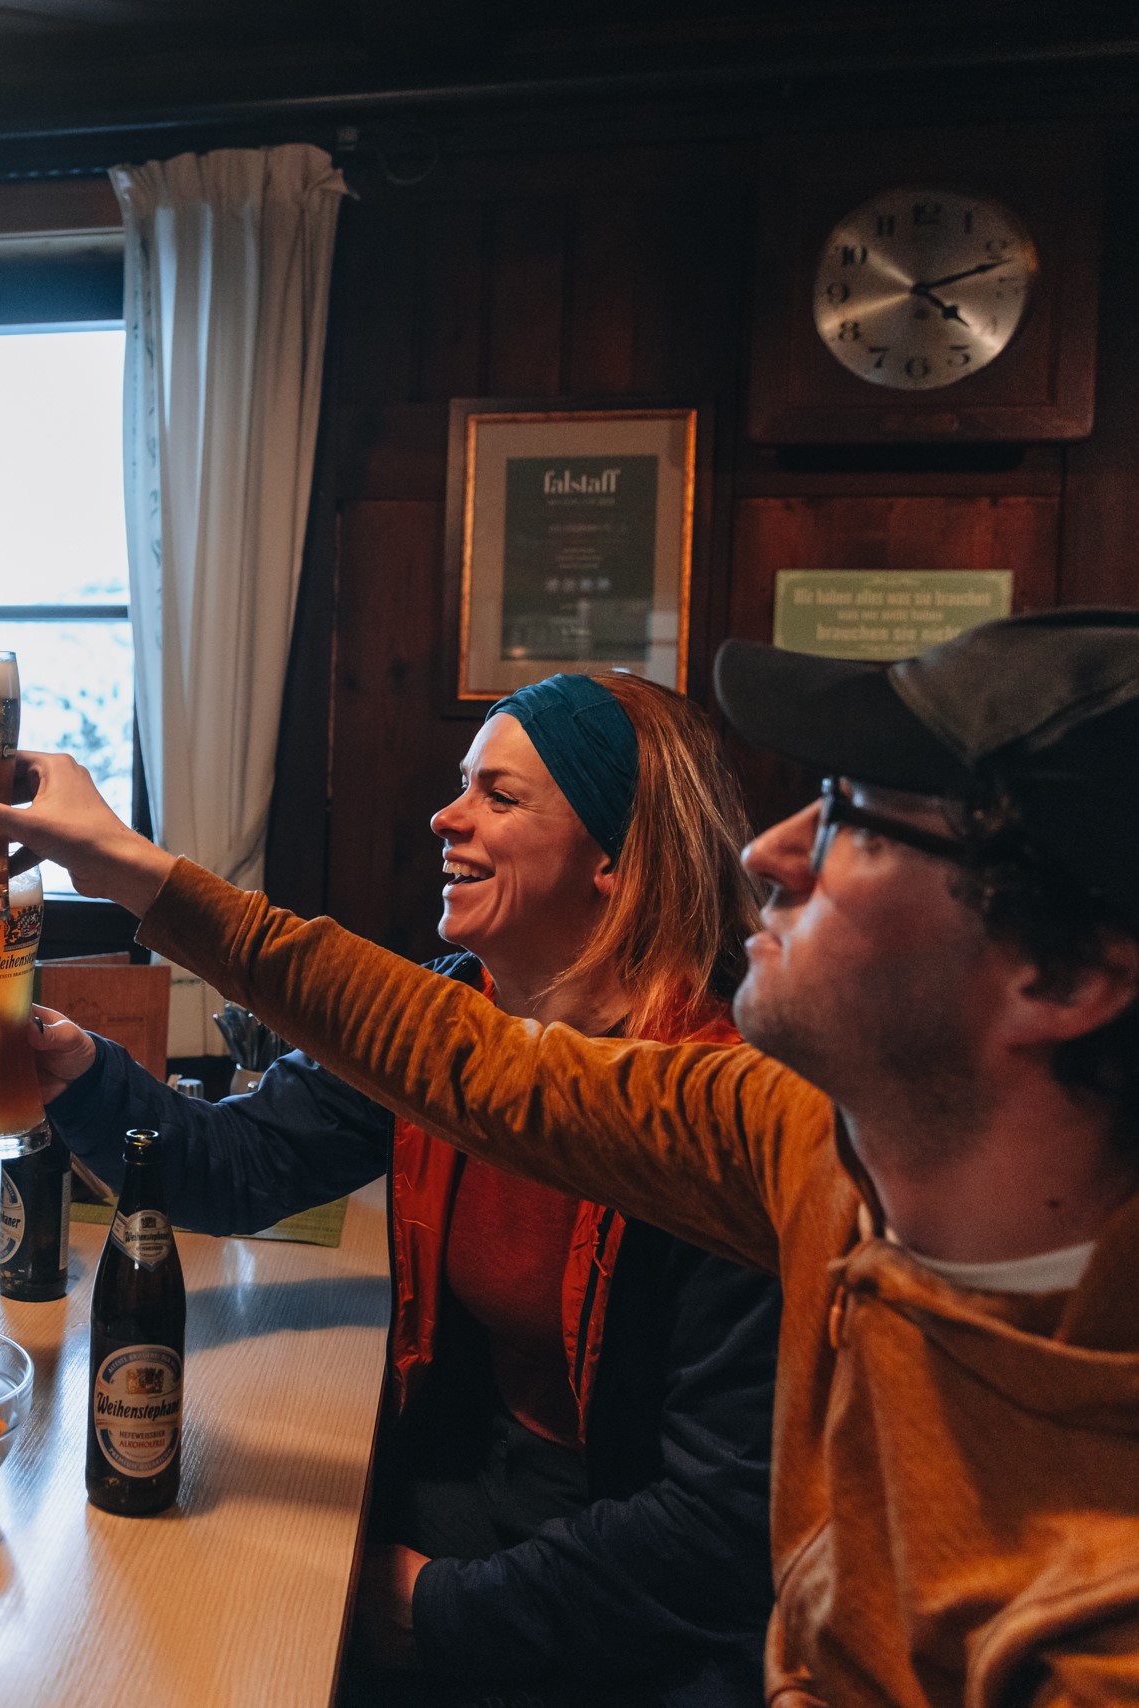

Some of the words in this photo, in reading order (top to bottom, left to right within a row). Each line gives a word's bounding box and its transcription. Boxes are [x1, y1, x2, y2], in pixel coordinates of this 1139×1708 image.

[914, 203, 941, 225] 12
[964, 210, 973, 233] 1
[877, 215, 895, 236] 11
[841, 245, 867, 266] 10
[826, 282, 850, 304] 9
[838, 320, 860, 341] 8
[868, 347, 889, 368] 7
[905, 356, 930, 378] 6
[947, 346, 970, 367] 5
[544, 468, 621, 494] falstaff
[816, 624, 890, 641] brauchen
